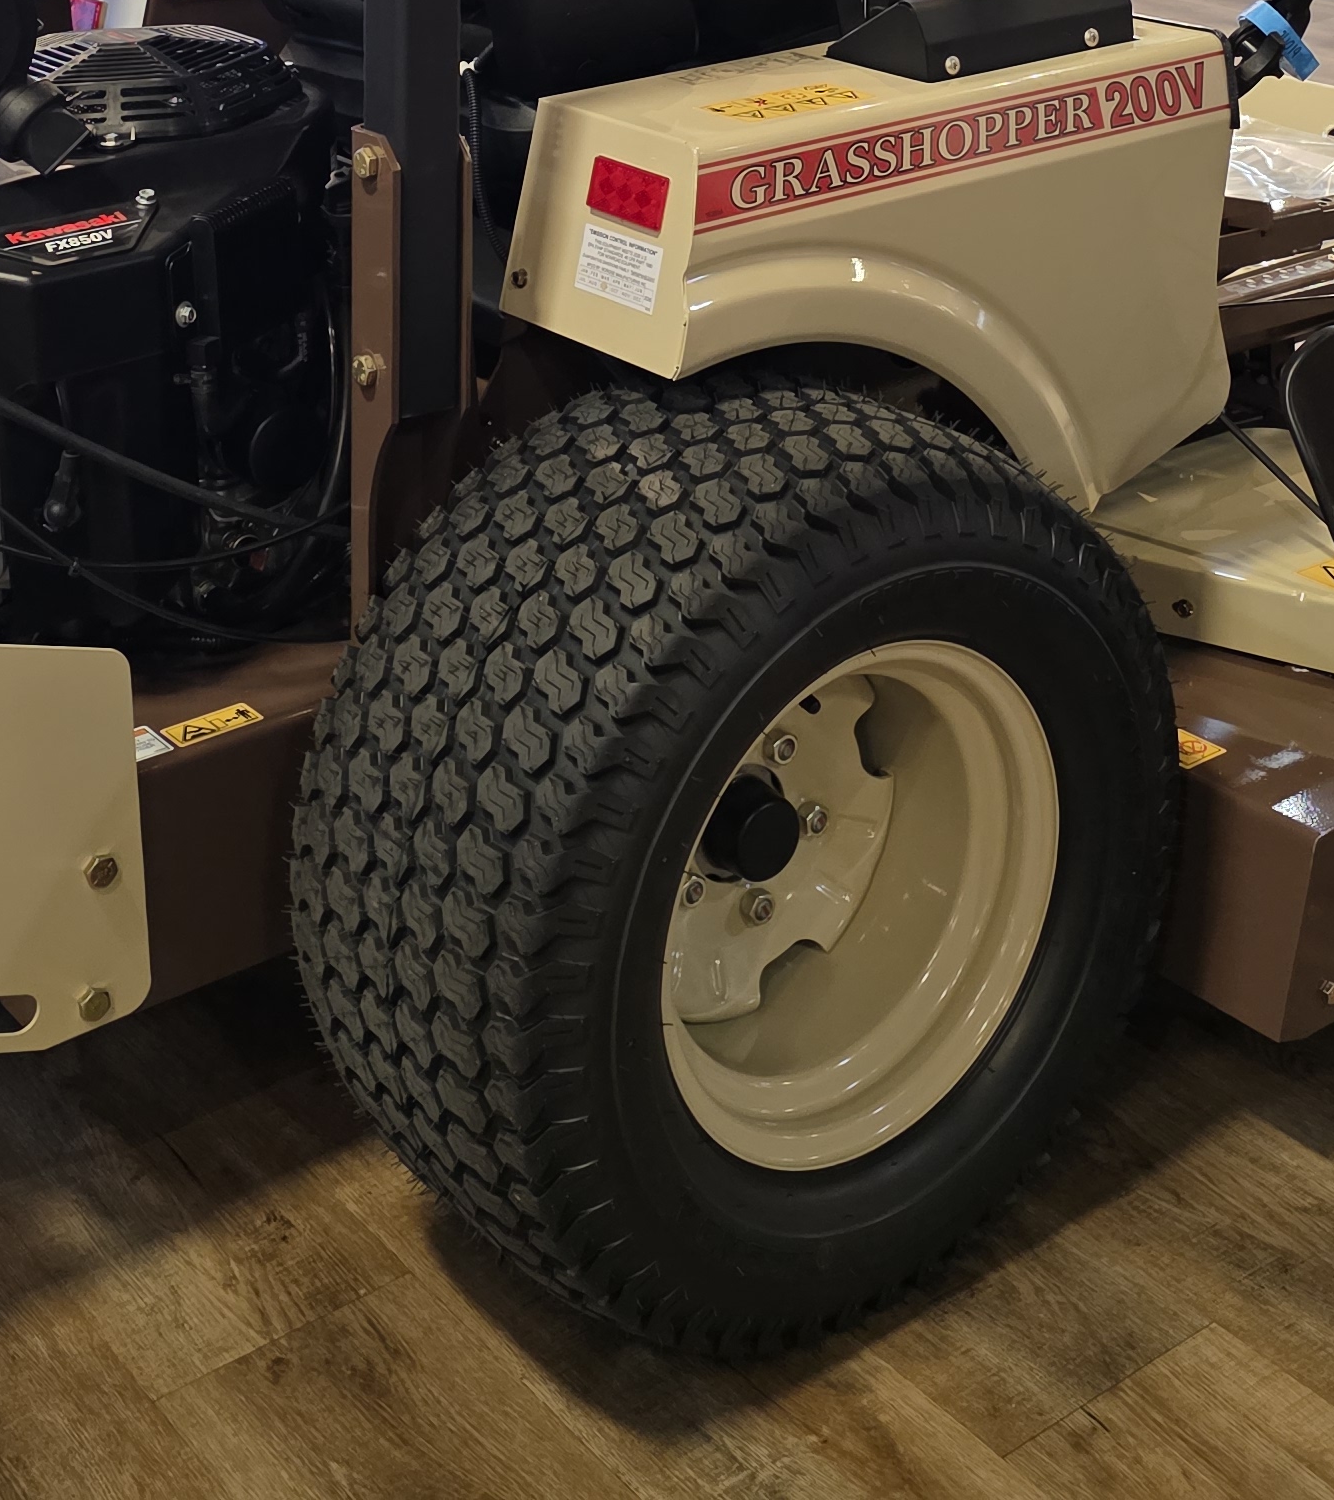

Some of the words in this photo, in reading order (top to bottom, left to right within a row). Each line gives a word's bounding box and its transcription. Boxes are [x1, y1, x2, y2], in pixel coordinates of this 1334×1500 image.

[729, 92, 1097, 211] GRASSHOPPER
[1104, 61, 1206, 129] 200V
[5, 211, 127, 244] Kawasaki
[45, 229, 113, 253] FX850V
